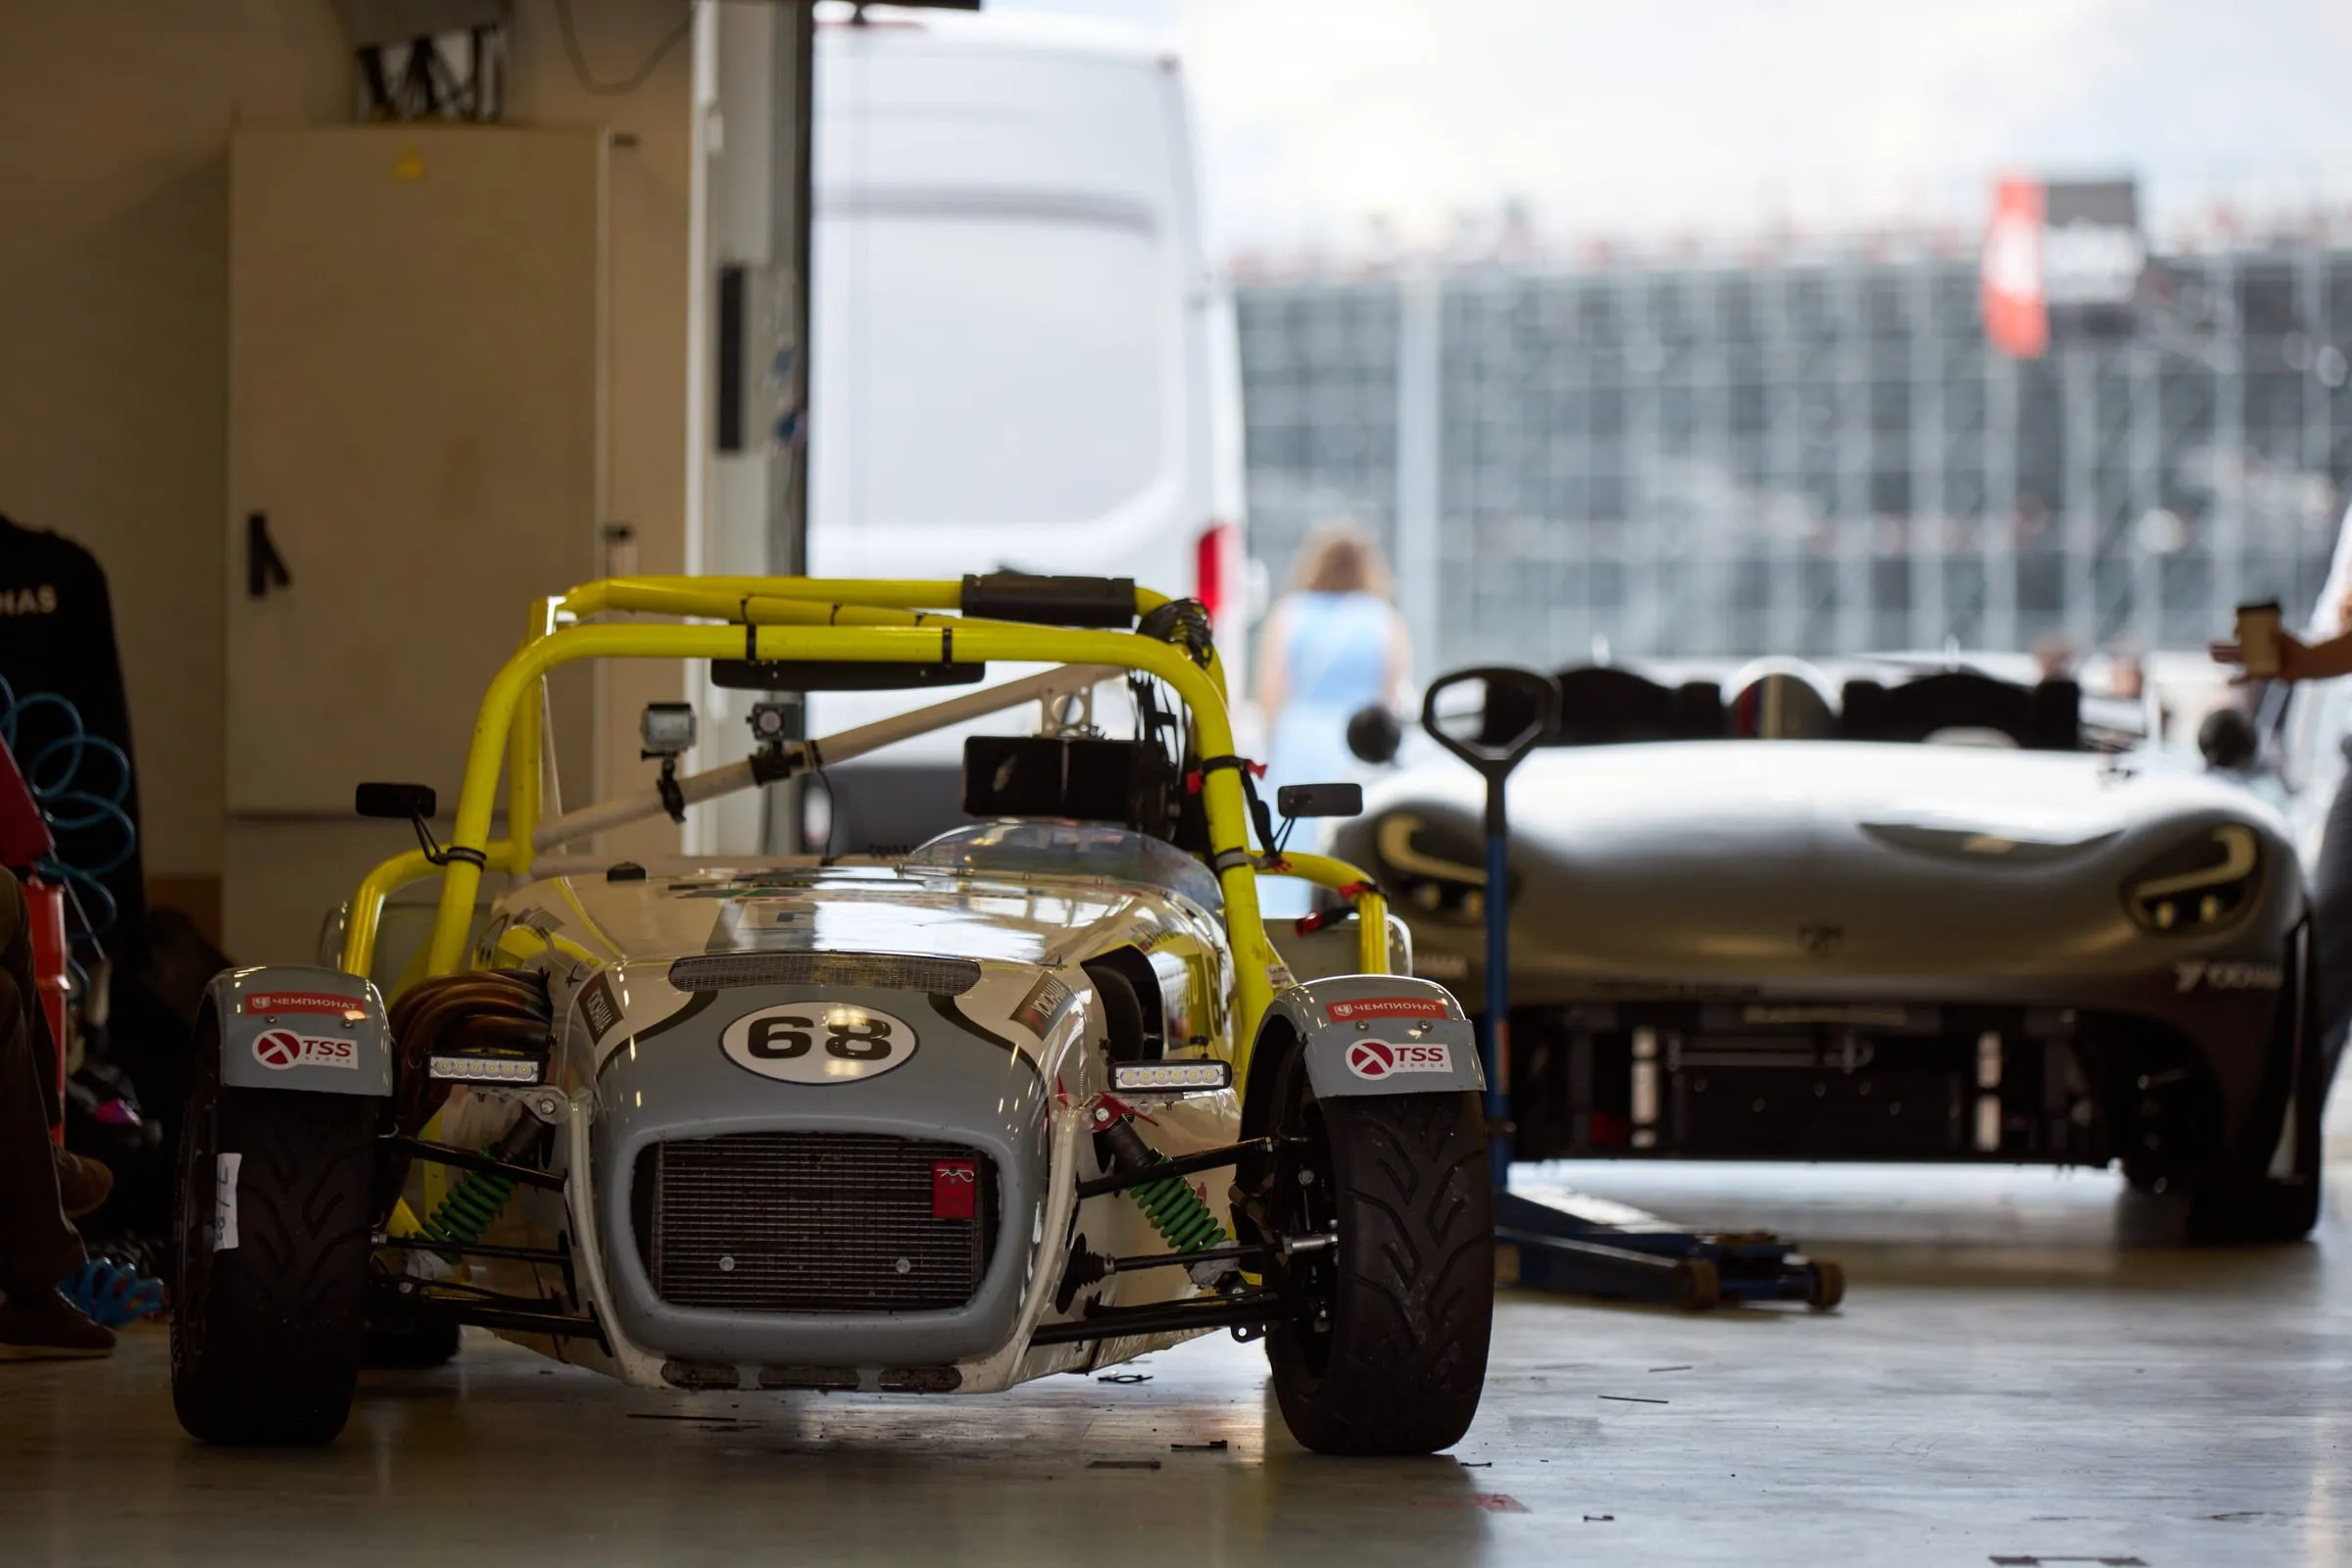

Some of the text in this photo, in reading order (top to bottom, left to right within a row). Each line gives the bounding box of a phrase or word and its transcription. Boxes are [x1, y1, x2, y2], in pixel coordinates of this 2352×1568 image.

[272, 998, 357, 1009] ЧЕМПИОНАТ
[1354, 1003, 1438, 1012] ЧЕМПИОНАТ
[748, 1016, 891, 1060] 68
[303, 1040, 352, 1057] TSS
[1395, 1048, 1444, 1061] TSS
